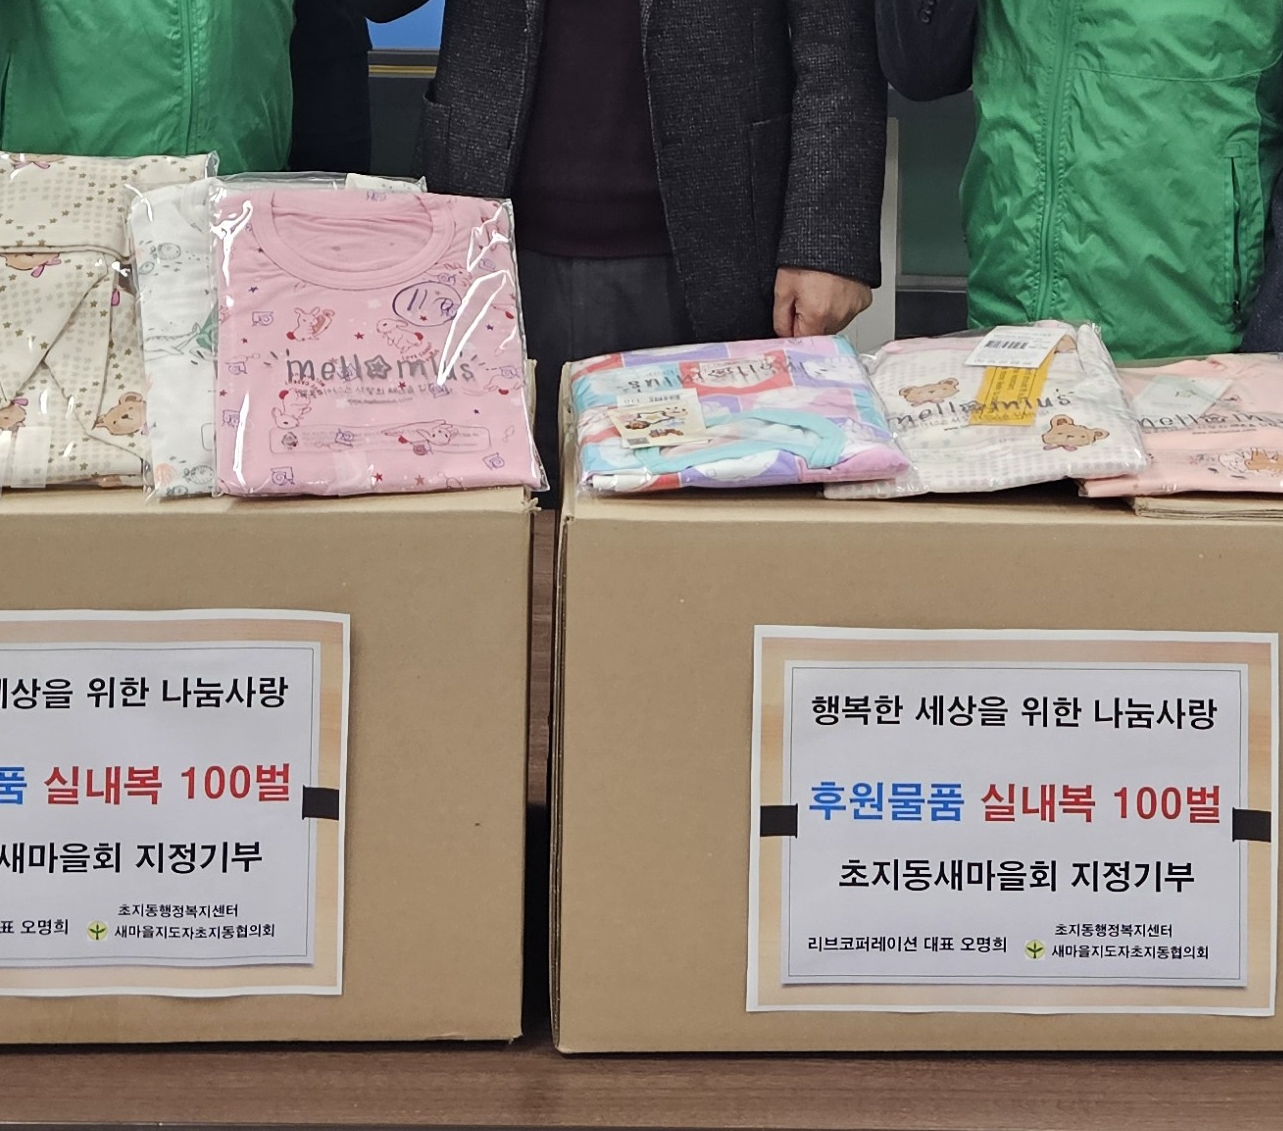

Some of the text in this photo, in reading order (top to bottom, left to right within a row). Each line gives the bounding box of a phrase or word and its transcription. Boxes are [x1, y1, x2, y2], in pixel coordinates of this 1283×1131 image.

[87, 677, 149, 708] 위한
[163, 677, 288, 707] 나눔사랑
[812, 695, 1217, 730] 행복한 세상을 위한 나눔사랑
[44, 766, 162, 805] 실내복
[182, 764, 289, 801] 100벌
[810, 782, 1219, 823] 후원물품 실내복 100벌
[136, 842, 262, 874] 지정기부
[839, 859, 1194, 892] 초지동새마을회 지정기부
[119, 904, 237, 918] 초지동행정복지센터
[21, 919, 68, 935] 오명희
[115, 924, 274, 939] 새마을지도자초지동협의회
[1055, 924, 1171, 937] 초지동행정복지센터
[809, 937, 1006, 952] 리브코퍼레이션 대표 오명희
[1052, 945, 1208, 959] 새마을지도자초지동협의회
